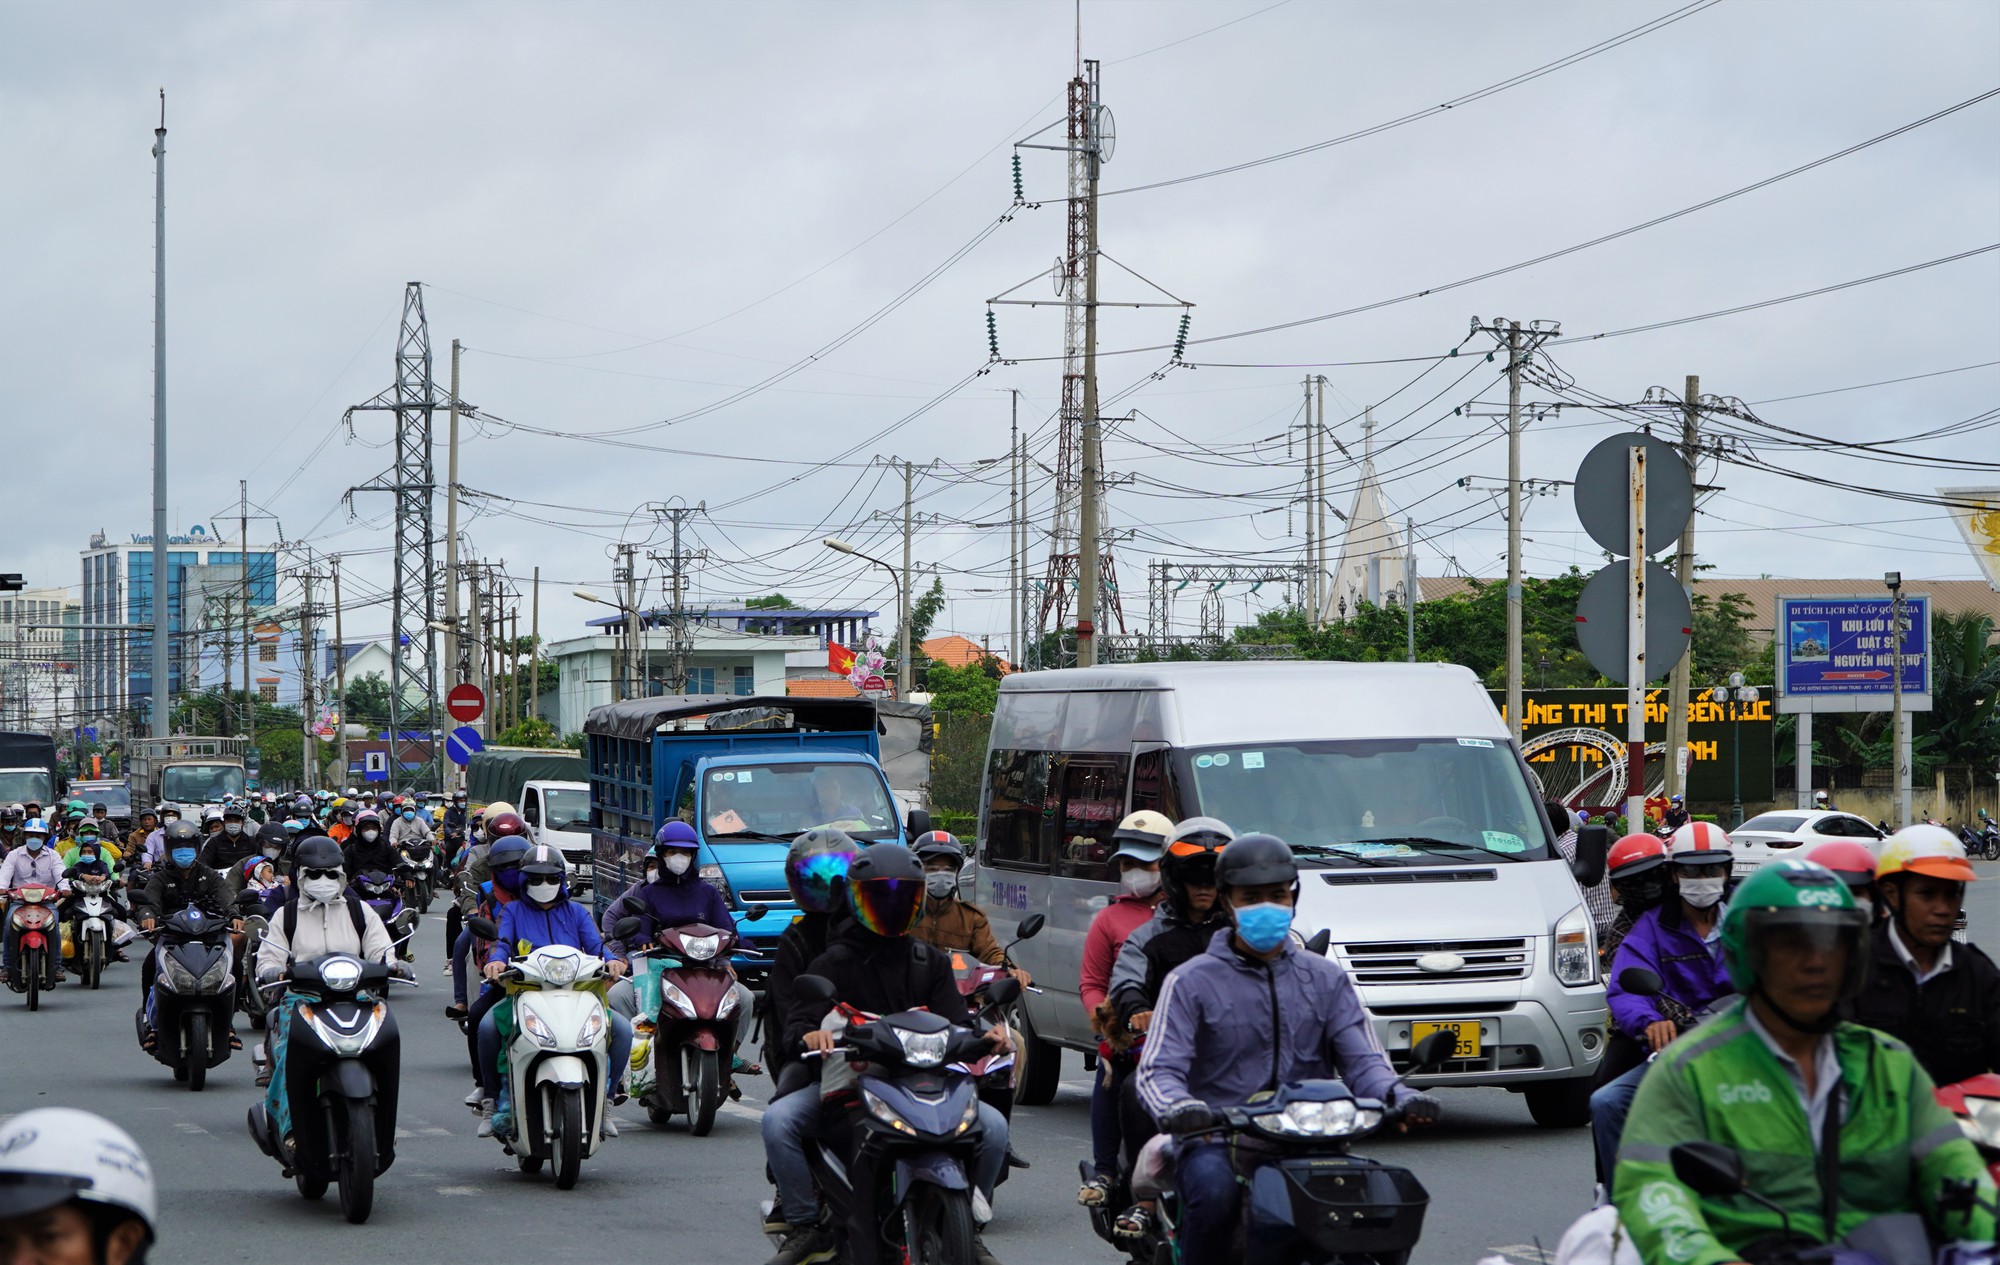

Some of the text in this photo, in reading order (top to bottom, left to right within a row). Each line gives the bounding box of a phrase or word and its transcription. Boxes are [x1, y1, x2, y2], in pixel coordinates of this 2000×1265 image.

[1803, 605, 1823, 615] TÍCH
[1860, 604, 1877, 615] CẤP
[1842, 620, 1863, 632] KHU
[1857, 635, 1881, 651] LUẬT
[1834, 651, 1874, 667] NGUYỄN
[1612, 689, 1670, 724] TẤN
[1797, 888, 1843, 907] Grab
[1717, 1080, 1772, 1105] Grab
